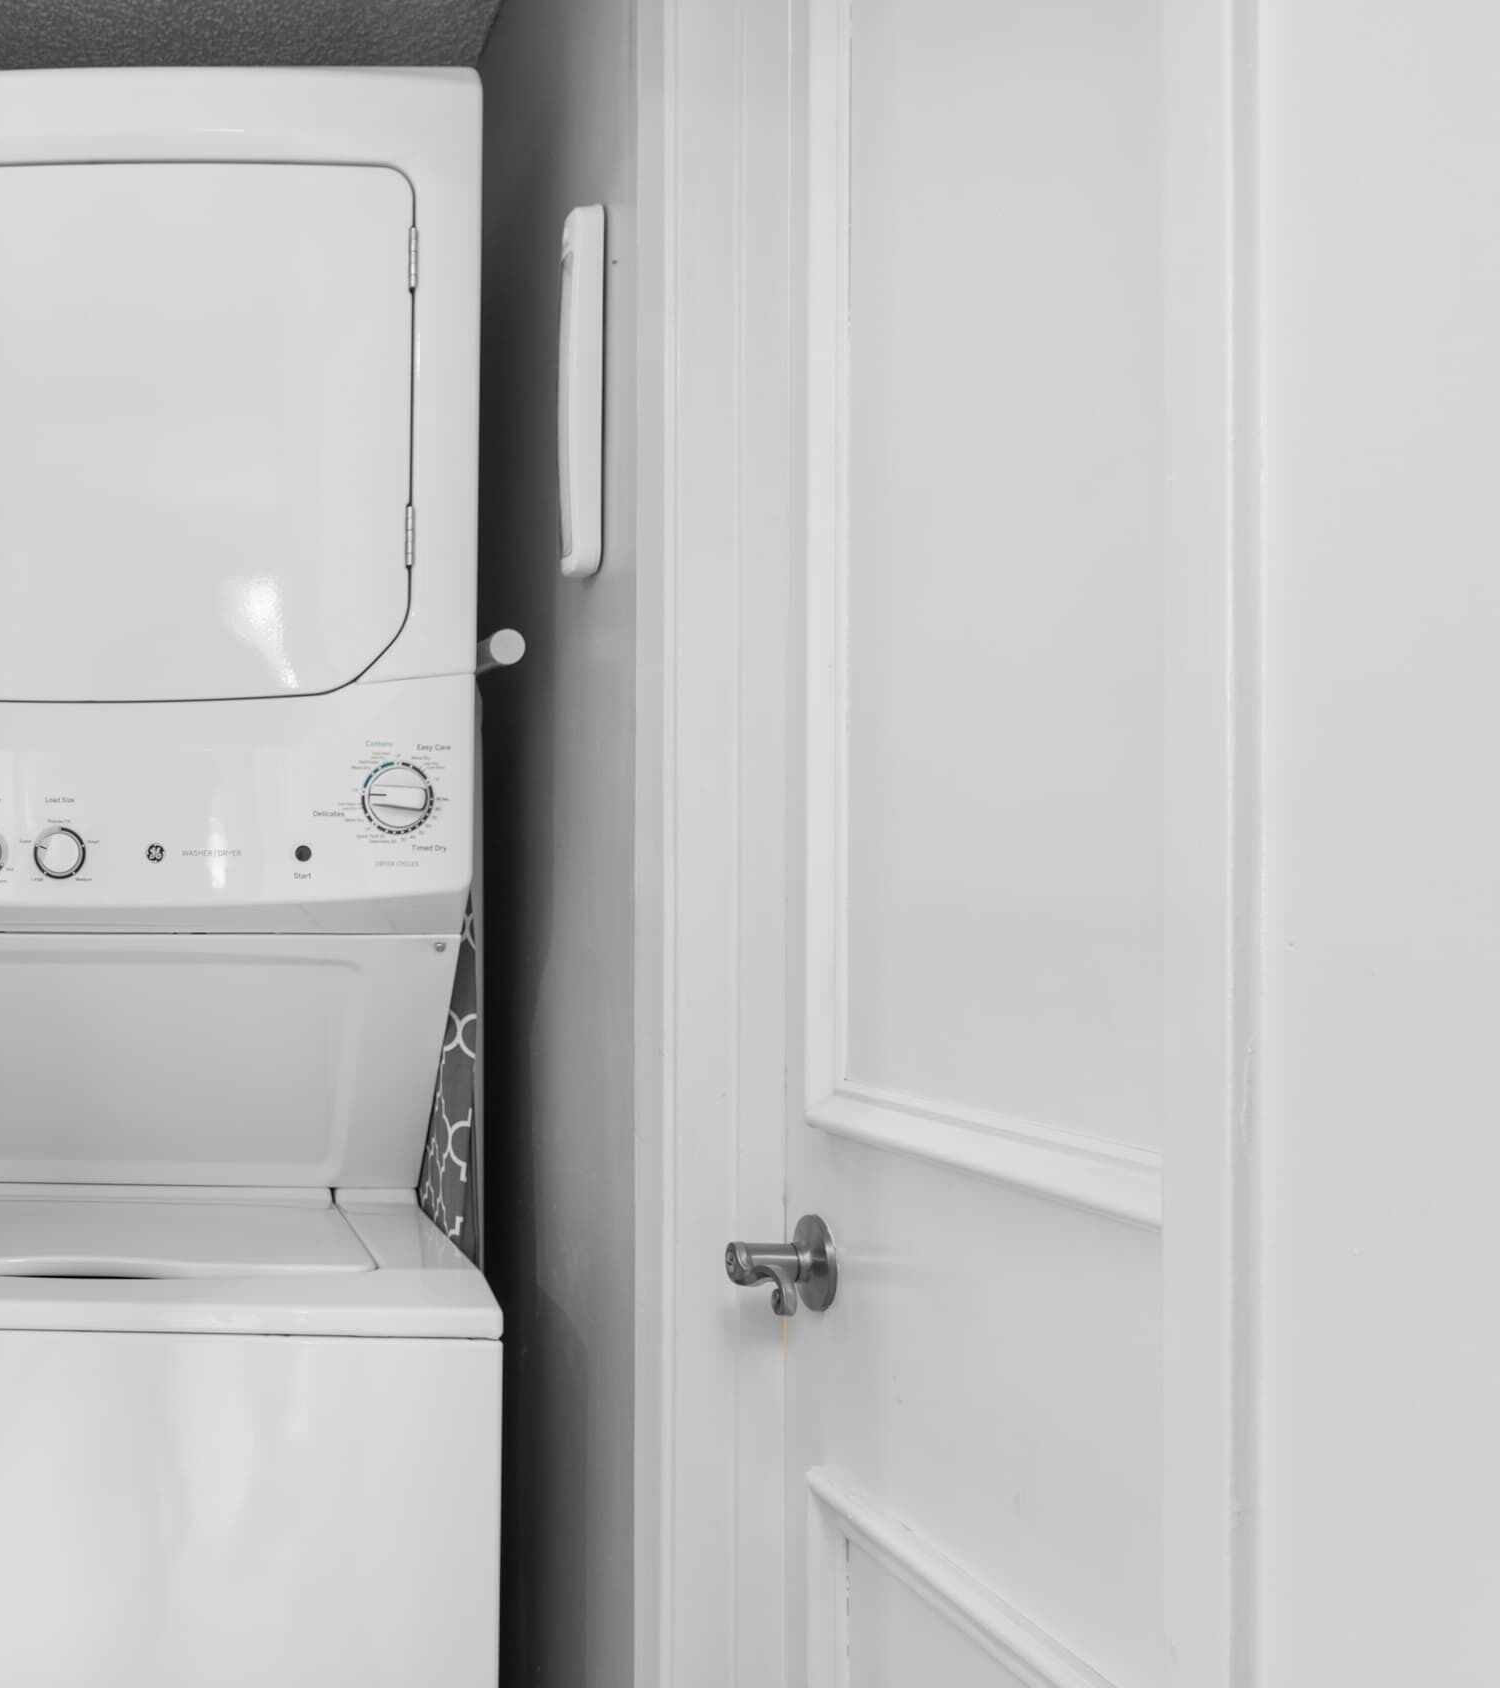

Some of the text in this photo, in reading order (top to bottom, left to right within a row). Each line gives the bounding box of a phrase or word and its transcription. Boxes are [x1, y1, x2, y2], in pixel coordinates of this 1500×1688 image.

[416, 744, 433, 752] Easy
[434, 844, 447, 853] Dry
[182, 849, 212, 857] WASHER
